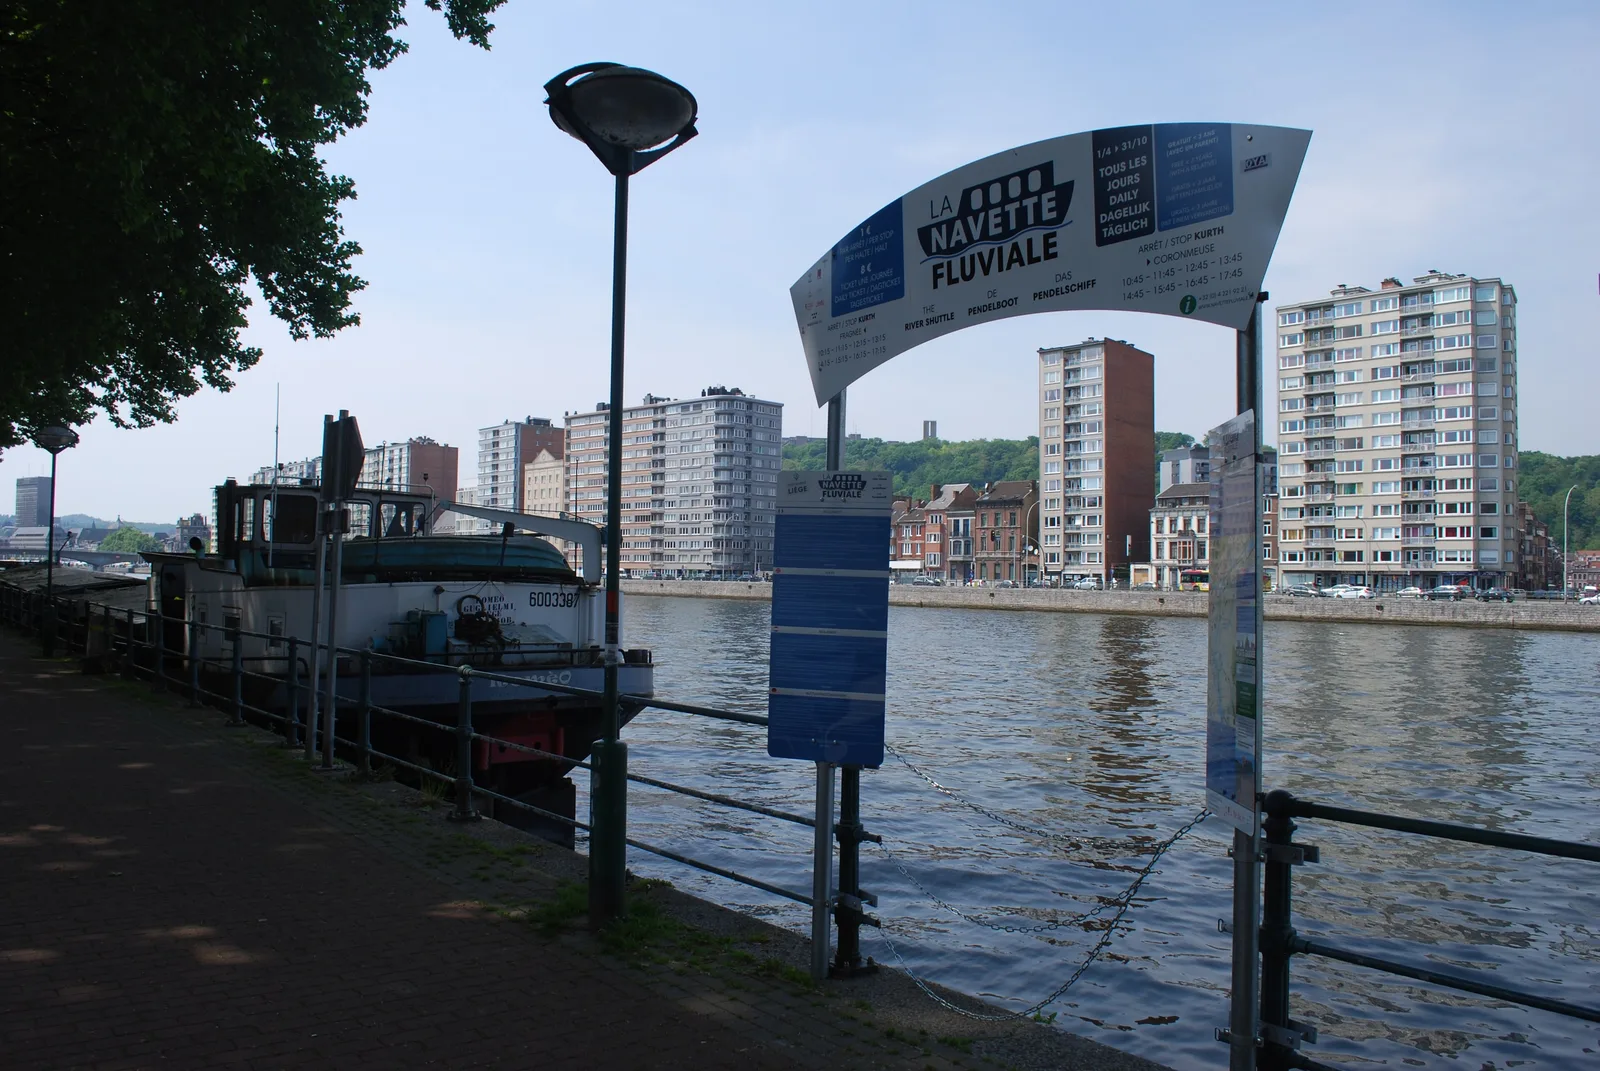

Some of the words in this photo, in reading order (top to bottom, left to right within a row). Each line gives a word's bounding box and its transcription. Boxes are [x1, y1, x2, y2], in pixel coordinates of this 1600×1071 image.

[1096, 147, 1112, 158] 1/4
[1121, 136, 1148, 150] 31/10
[1099, 162, 1126, 177] TOUS
[1129, 156, 1147, 169] LES
[1107, 173, 1140, 191] JOURS
[1110, 189, 1139, 206] DAILY
[930, 195, 952, 220] LA
[1100, 201, 1150, 223] DAGELIJK
[931, 190, 1057, 252] NAVETTE
[1102, 218, 1148, 238] TÄGLICH
[869, 235, 879, 245] PER
[880, 230, 894, 241] STOP
[1138, 240, 1163, 255] ARRÊT
[1170, 233, 1192, 246] STOP
[1194, 226, 1224, 240] KURTH
[845, 256, 854, 264] PER
[855, 248, 871, 260] HALTE
[874, 242, 888, 255] HALT
[932, 230, 1058, 289] FLUVIALE
[1154, 243, 1215, 265] CORONMEUSE
[1055, 271, 1072, 283] DAS
[1122, 275, 1144, 286] 10:45
[1153, 268, 1175, 280] 11:45
[1185, 260, 1208, 272] 12:45
[1219, 253, 1242, 265] 13:45
[834, 294, 848, 304] DAILY
[849, 287, 866, 298] TICKET
[870, 276, 901, 293] DAGTICKET
[840, 279, 857, 291] TICKET
[987, 289, 997, 299] DE
[1033, 279, 1097, 301] PENDELSCHIFF
[1122, 290, 1144, 301] 14:45
[1154, 283, 1175, 294] 15:45
[1185, 275, 1208, 288] 16:45
[1219, 268, 1242, 280] 17:45
[850, 293, 884, 309] TAGESTICKET
[922, 304, 935, 315] THE
[968, 297, 1018, 316] PENDELBOOT
[845, 318, 857, 327] STOP
[858, 312, 876, 323] KURTH
[904, 317, 924, 331] RIVER
[926, 312, 954, 326] SHUTTLE
[822, 481, 862, 489] NAVETTE
[822, 490, 862, 498] FLUVIALE
[464, 603, 516, 612] GUGIELMI,
[530, 592, 580, 608] 6003387
